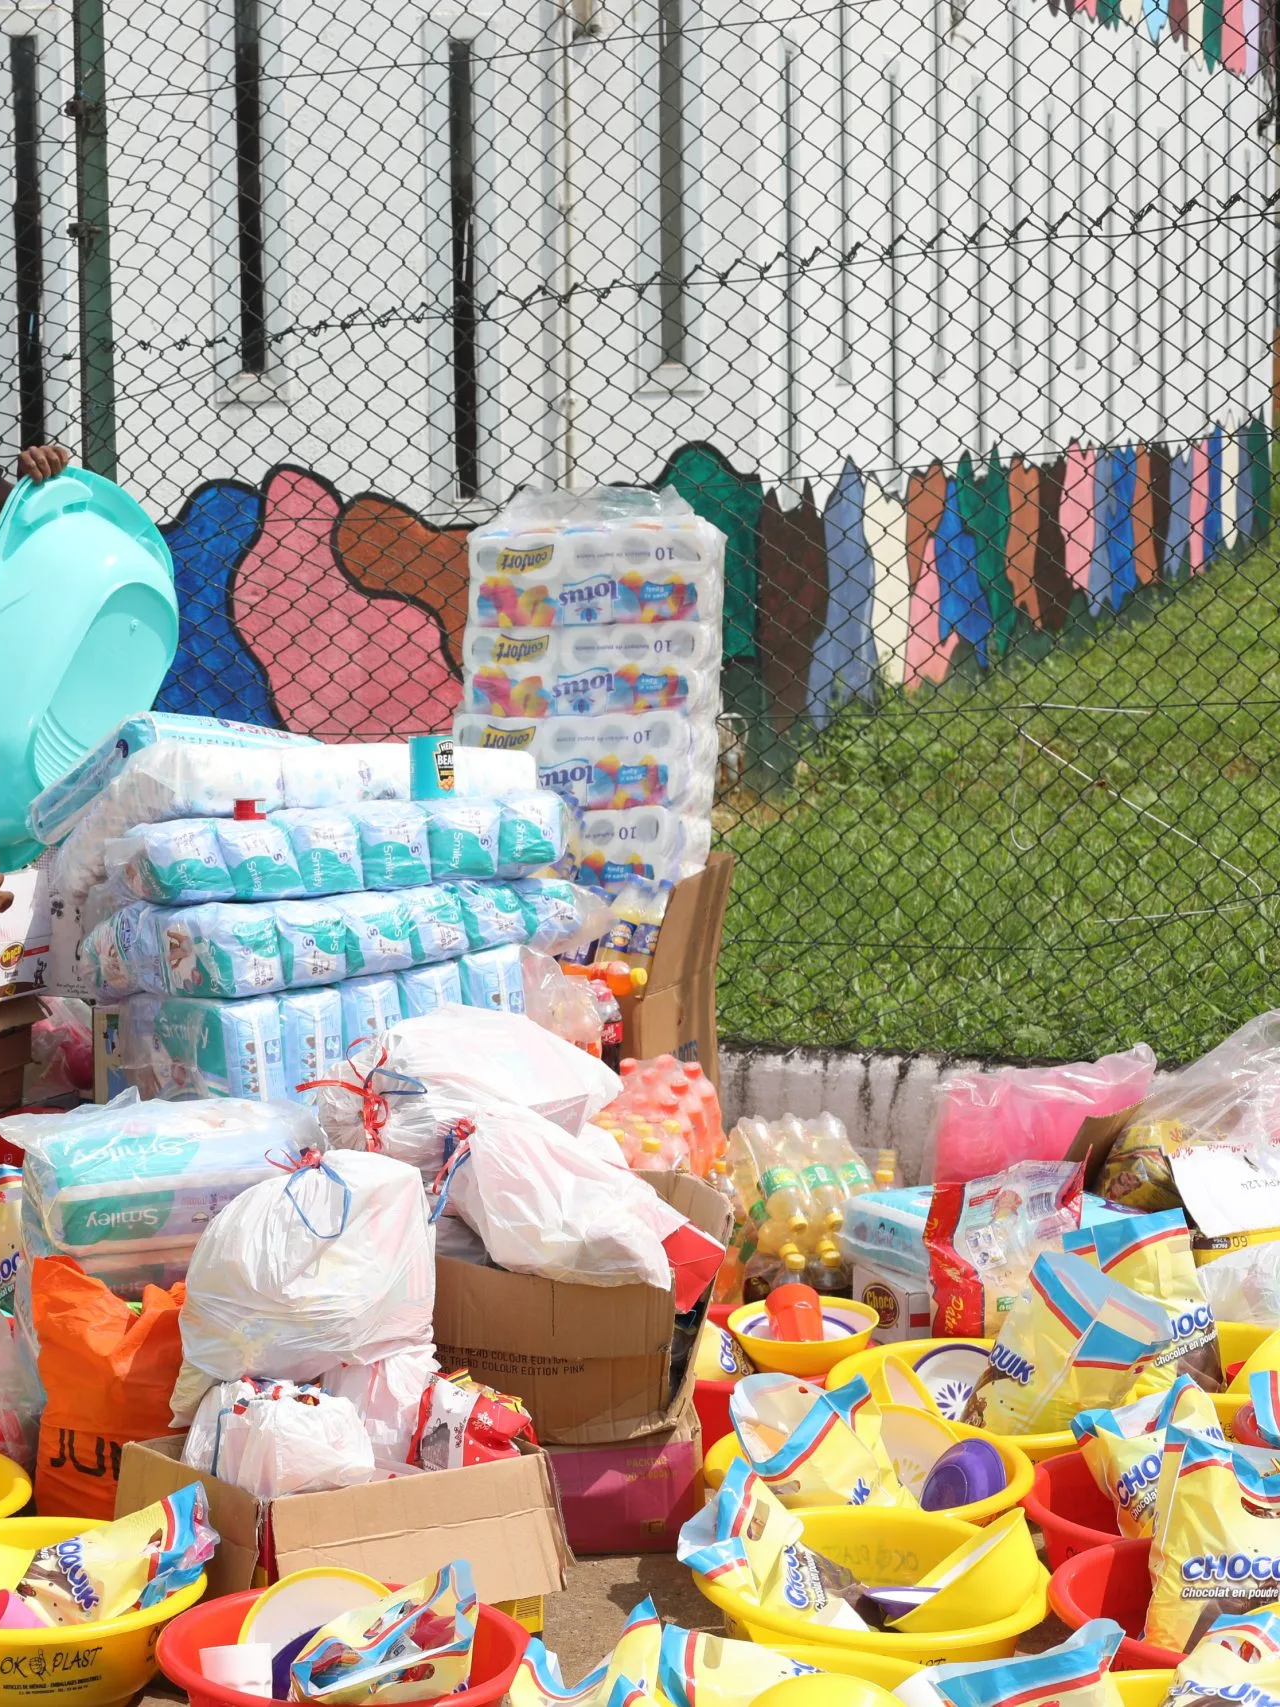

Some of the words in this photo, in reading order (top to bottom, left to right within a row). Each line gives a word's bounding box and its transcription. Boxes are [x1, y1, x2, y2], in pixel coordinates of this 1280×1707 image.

[500, 551, 548, 571] confort
[655, 547, 674, 560] 10
[559, 580, 618, 606] lotus
[496, 642, 544, 662] confort
[654, 640, 672, 653] 10
[552, 672, 616, 699] lotus
[440, 742, 454, 751] HEI
[483, 732, 530, 749] confort
[634, 730, 653, 744] 10
[437, 754, 454, 766] BEA
[619, 827, 636, 840] 10
[451, 832, 464, 870] Smiley
[383, 845, 395, 881] Smiley
[86, 1208, 159, 1229] Smiley
[1232, 1235, 1248, 1248] 60
[866, 1291, 894, 1310] Choco
[1154, 1345, 1188, 1367] Chocolat
[1189, 1339, 1199, 1352] en
[451, 1357, 479, 1369] TREND
[482, 1362, 519, 1374] COLOUR
[521, 1366, 559, 1376] EDITION
[563, 1364, 586, 1375] PINK
[990, 1342, 1036, 1385] QUIK
[1117, 1449, 1163, 1507] CHO
[1182, 1586, 1229, 1598] Chocolat
[1233, 1588, 1245, 1598] en
[1248, 1586, 1280, 1599] poudre
[0, 1656, 28, 1678] OK
[52, 1646, 103, 1672] PLAST
